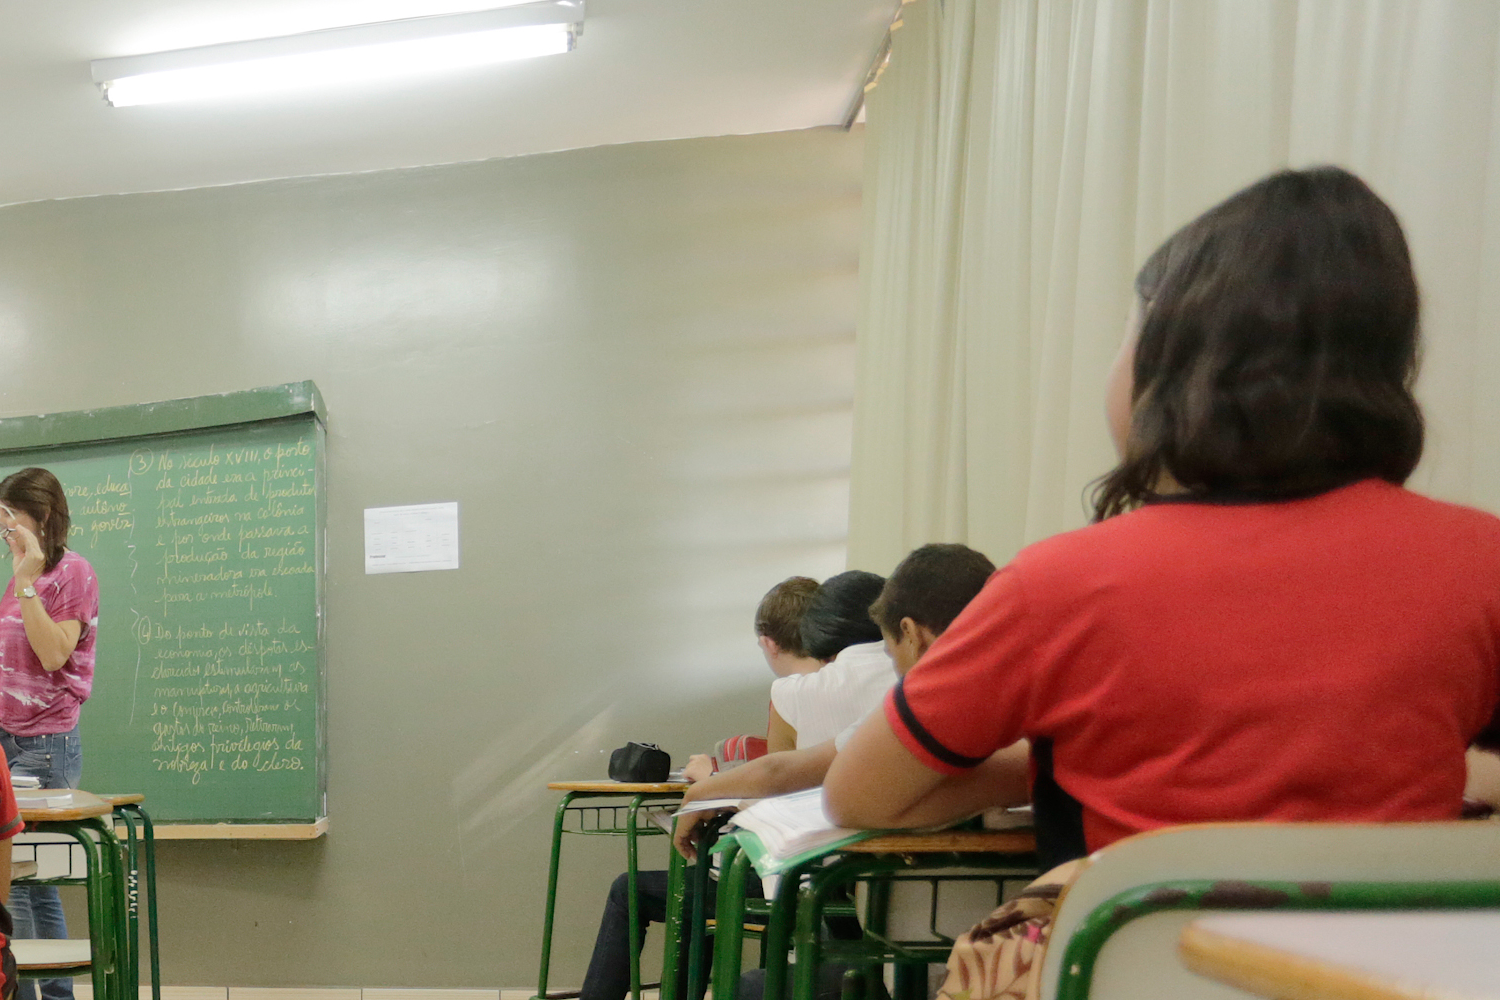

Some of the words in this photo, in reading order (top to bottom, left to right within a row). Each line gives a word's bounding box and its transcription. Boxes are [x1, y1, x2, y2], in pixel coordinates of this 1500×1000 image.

[158, 449, 173, 471] No
[263, 447, 273, 460] o
[156, 471, 175, 491] da
[180, 466, 218, 488] cidade
[222, 473, 243, 483] era
[245, 472, 257, 482] a
[189, 486, 238, 507] entrada
[244, 484, 259, 502] de
[235, 512, 252, 521] na
[155, 534, 166, 546] e
[202, 526, 231, 543] onde
[238, 525, 295, 552] passava
[297, 525, 309, 535] a
[155, 546, 227, 578] produção
[241, 542, 259, 560] da
[156, 566, 243, 584] mineradora
[155, 587, 192, 617] para
[196, 593, 207, 601] a
[154, 622, 171, 640] Do
[176, 622, 213, 649] ponto
[219, 622, 234, 640] de
[277, 616, 301, 634] da
[285, 732, 303, 750] da
[219, 760, 226, 771] e
[231, 754, 248, 771] do
